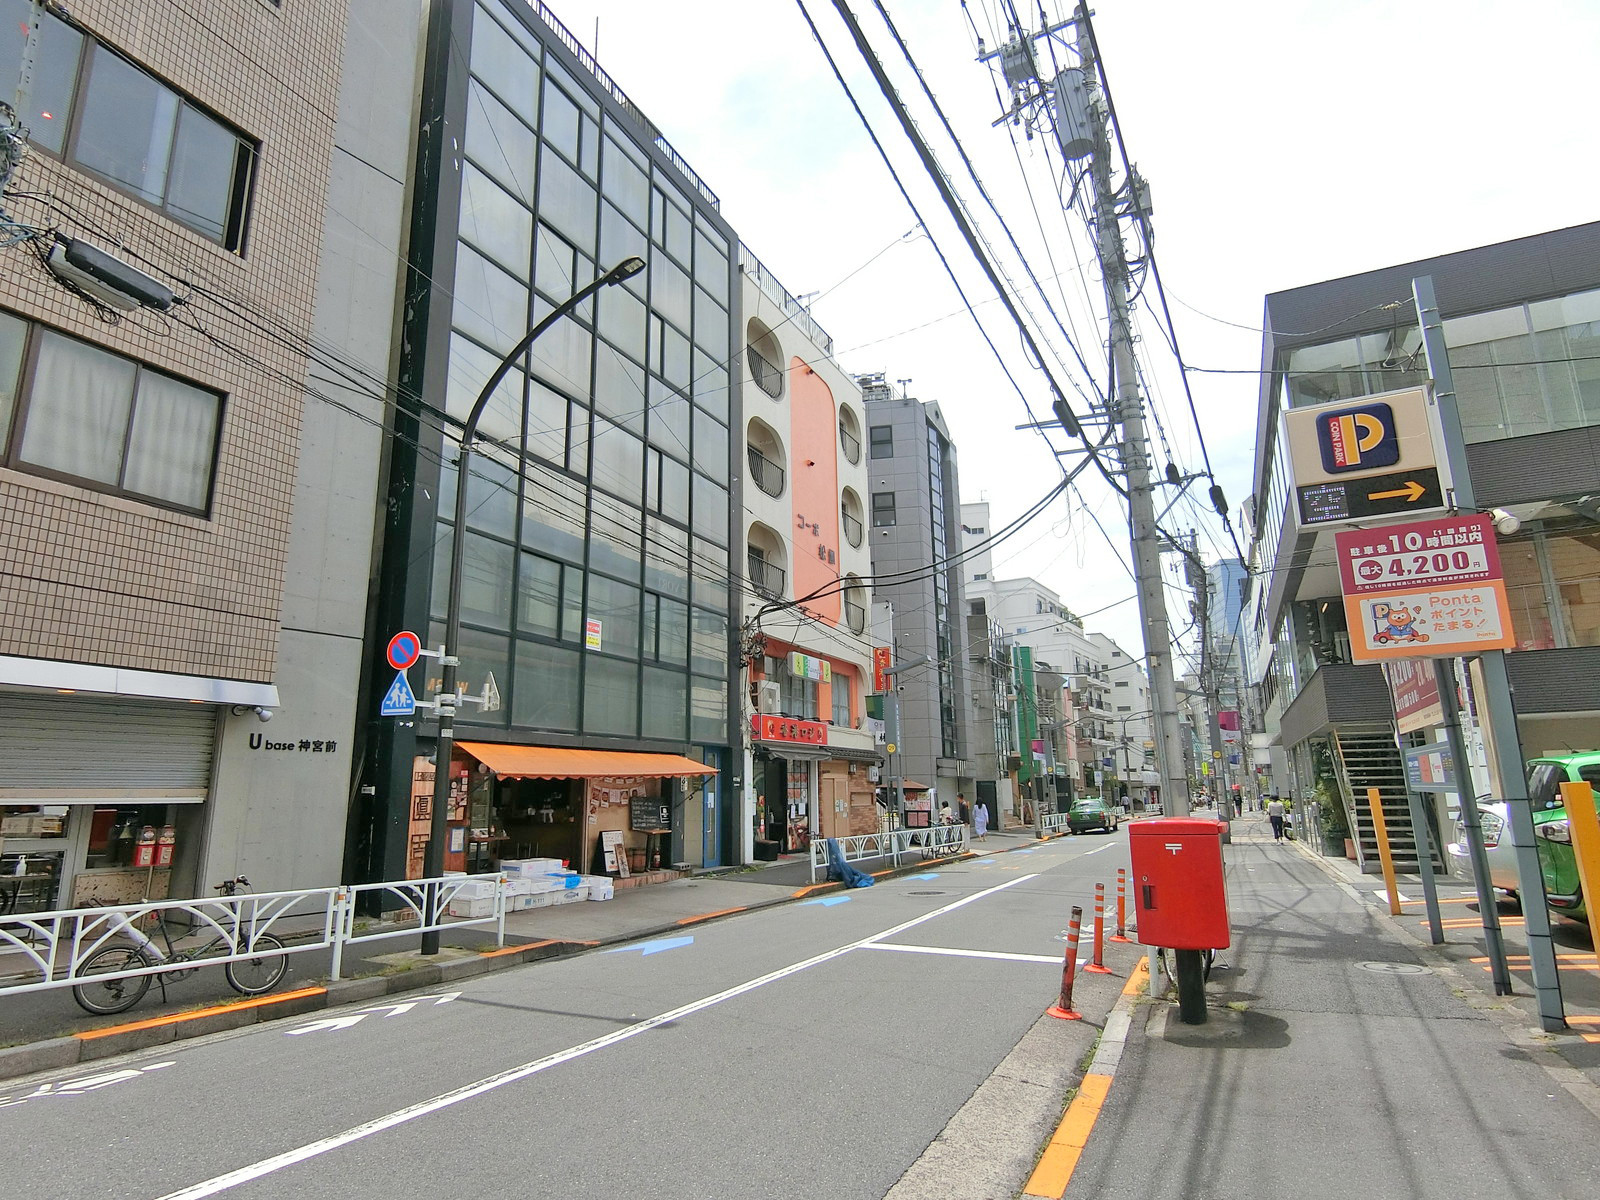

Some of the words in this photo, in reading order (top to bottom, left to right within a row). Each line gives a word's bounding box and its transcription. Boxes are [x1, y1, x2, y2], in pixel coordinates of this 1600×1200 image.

[1329, 421, 1340, 438] COIN
[1332, 441, 1345, 464] PARK
[1359, 564, 1382, 576] 最大
[1428, 593, 1482, 608] Ponta
[1430, 606, 1483, 620] ポイント
[249, 733, 263, 750] U
[265, 739, 295, 751] base
[298, 739, 338, 753] 神宮前
